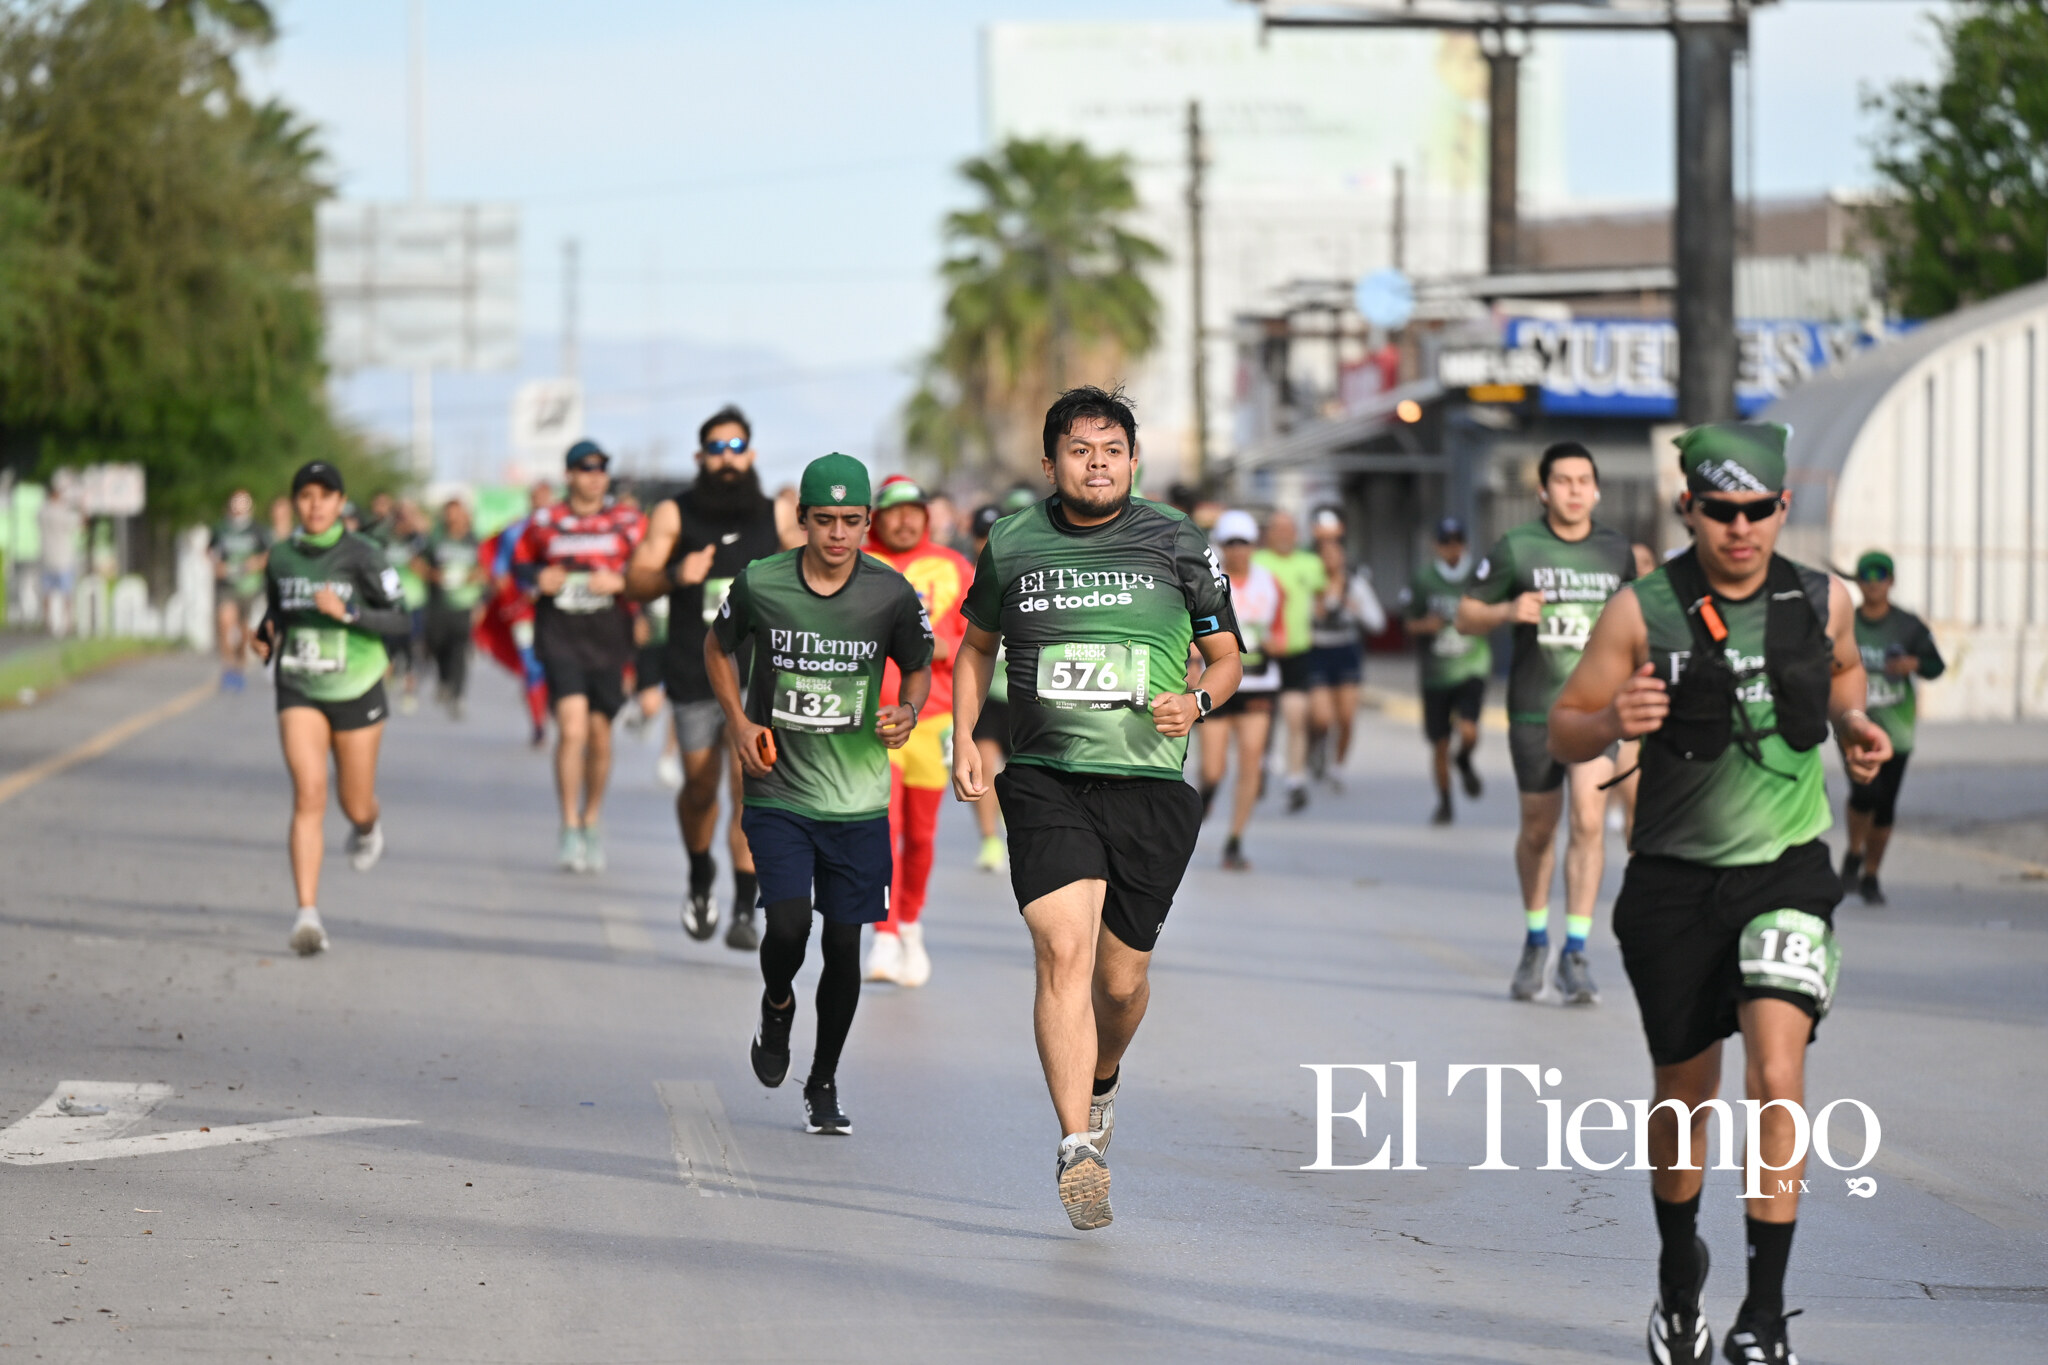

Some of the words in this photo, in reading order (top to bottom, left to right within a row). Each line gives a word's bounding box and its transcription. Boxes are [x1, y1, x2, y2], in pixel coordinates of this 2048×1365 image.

[1019, 570, 1046, 594] El
[1050, 568, 1154, 591] Tiempo
[1019, 597, 1050, 612] de
[1053, 591, 1133, 609] todos
[770, 628, 793, 652] El
[796, 631, 877, 660] Tiempo
[772, 654, 795, 669] de
[797, 658, 859, 672] todos
[1051, 662, 1118, 690] 576
[1136, 659, 1146, 706] MEDALLA
[786, 689, 841, 717] 132
[853, 689, 864, 726] MEDALLA
